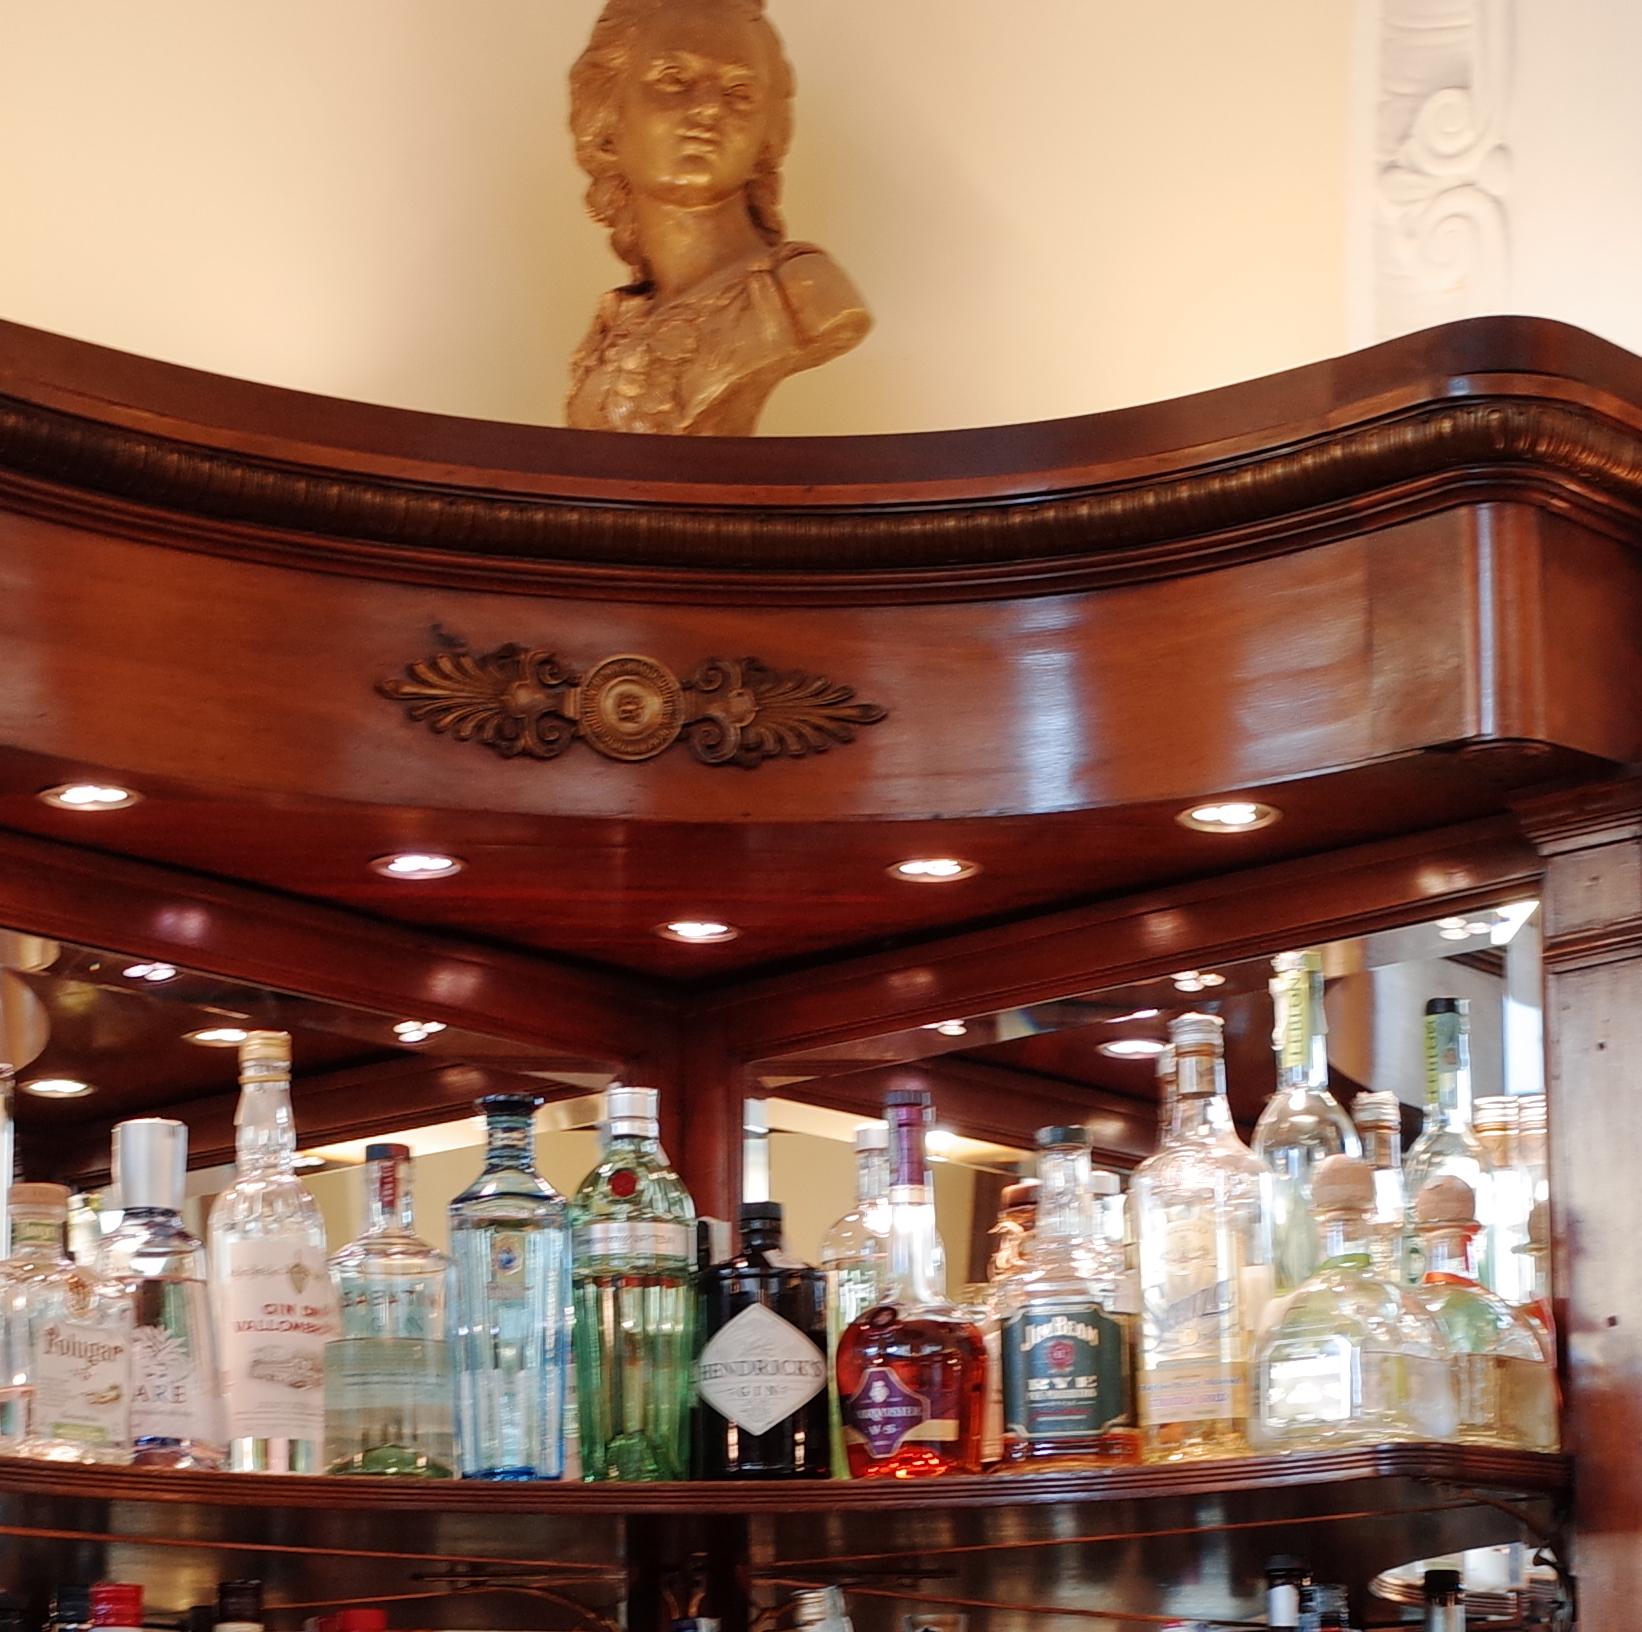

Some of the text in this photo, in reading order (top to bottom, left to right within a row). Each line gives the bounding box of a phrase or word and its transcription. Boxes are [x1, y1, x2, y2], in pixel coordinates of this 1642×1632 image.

[698, 1358, 826, 1379] HENDRICK'S
[1027, 1375, 1098, 1390] RYE
[132, 1385, 186, 1404] ARE
